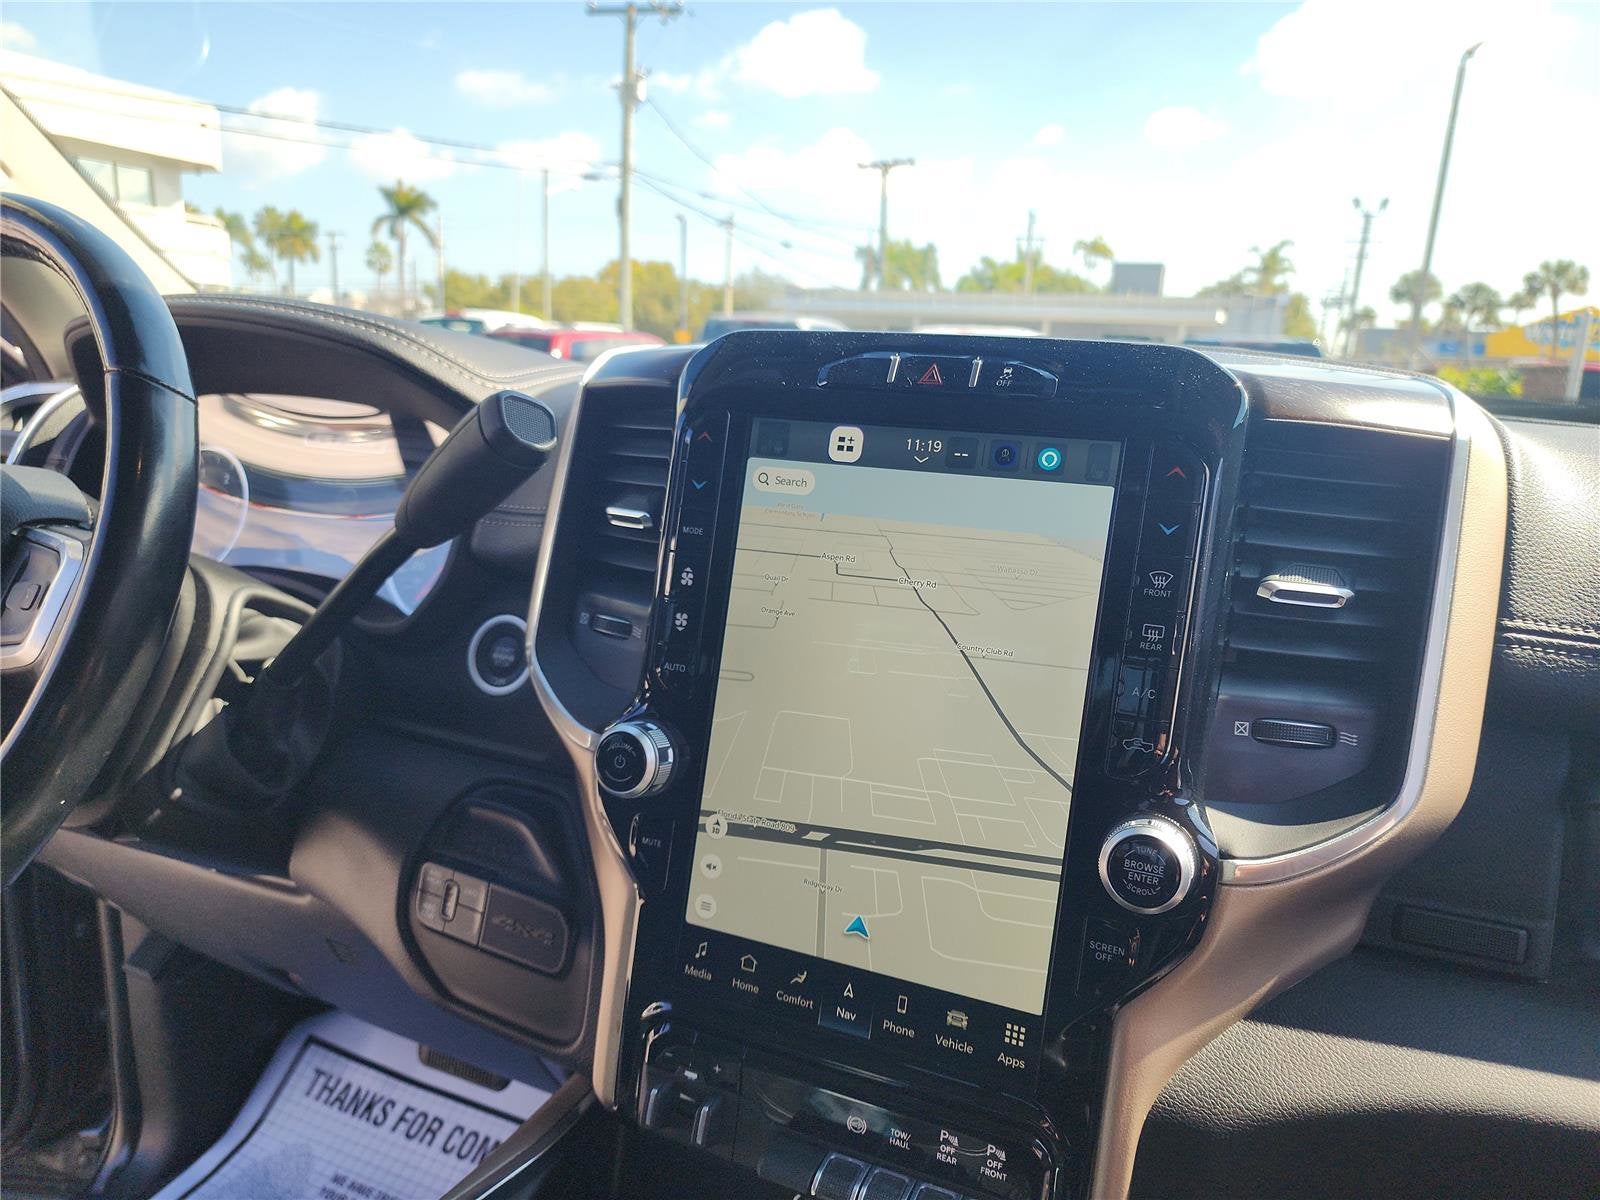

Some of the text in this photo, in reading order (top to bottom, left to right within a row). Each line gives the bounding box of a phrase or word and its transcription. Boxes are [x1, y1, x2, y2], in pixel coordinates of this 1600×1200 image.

[906, 437, 942, 453] 11:19
[774, 475, 808, 488] Search
[682, 525, 704, 536] MODE
[821, 552, 856, 563] Aspen Rd
[898, 577, 937, 589] Cherry Rd
[1143, 588, 1172, 598] FRONT
[957, 643, 984, 653] Country
[985, 647, 1002, 656] Club
[1139, 641, 1162, 651] REAR
[664, 661, 686, 673] AUTO
[1131, 686, 1156, 700] A/C
[761, 818, 780, 828] Road
[1124, 859, 1165, 875] BROWSE
[1128, 871, 1159, 886] ENTER
[1089, 940, 1125, 956] SCREEN
[1095, 951, 1113, 963] OFF
[684, 963, 713, 982] Media
[731, 977, 759, 994] Home
[775, 990, 814, 1009] Comfort
[836, 1005, 857, 1022] Nav
[882, 1019, 916, 1038] Phone
[935, 1034, 974, 1055] Vehicle
[997, 1051, 1026, 1069] Apps
[305, 1068, 395, 1127] THANKS
[392, 1106, 444, 1146] FOR
[890, 1127, 912, 1141] TOW/
[889, 1137, 911, 1150] HAUL
[940, 1144, 956, 1155] OFF
[936, 1151, 958, 1166] REAR
[986, 1159, 1003, 1170] OFF
[980, 1165, 1008, 1182] FRONT
